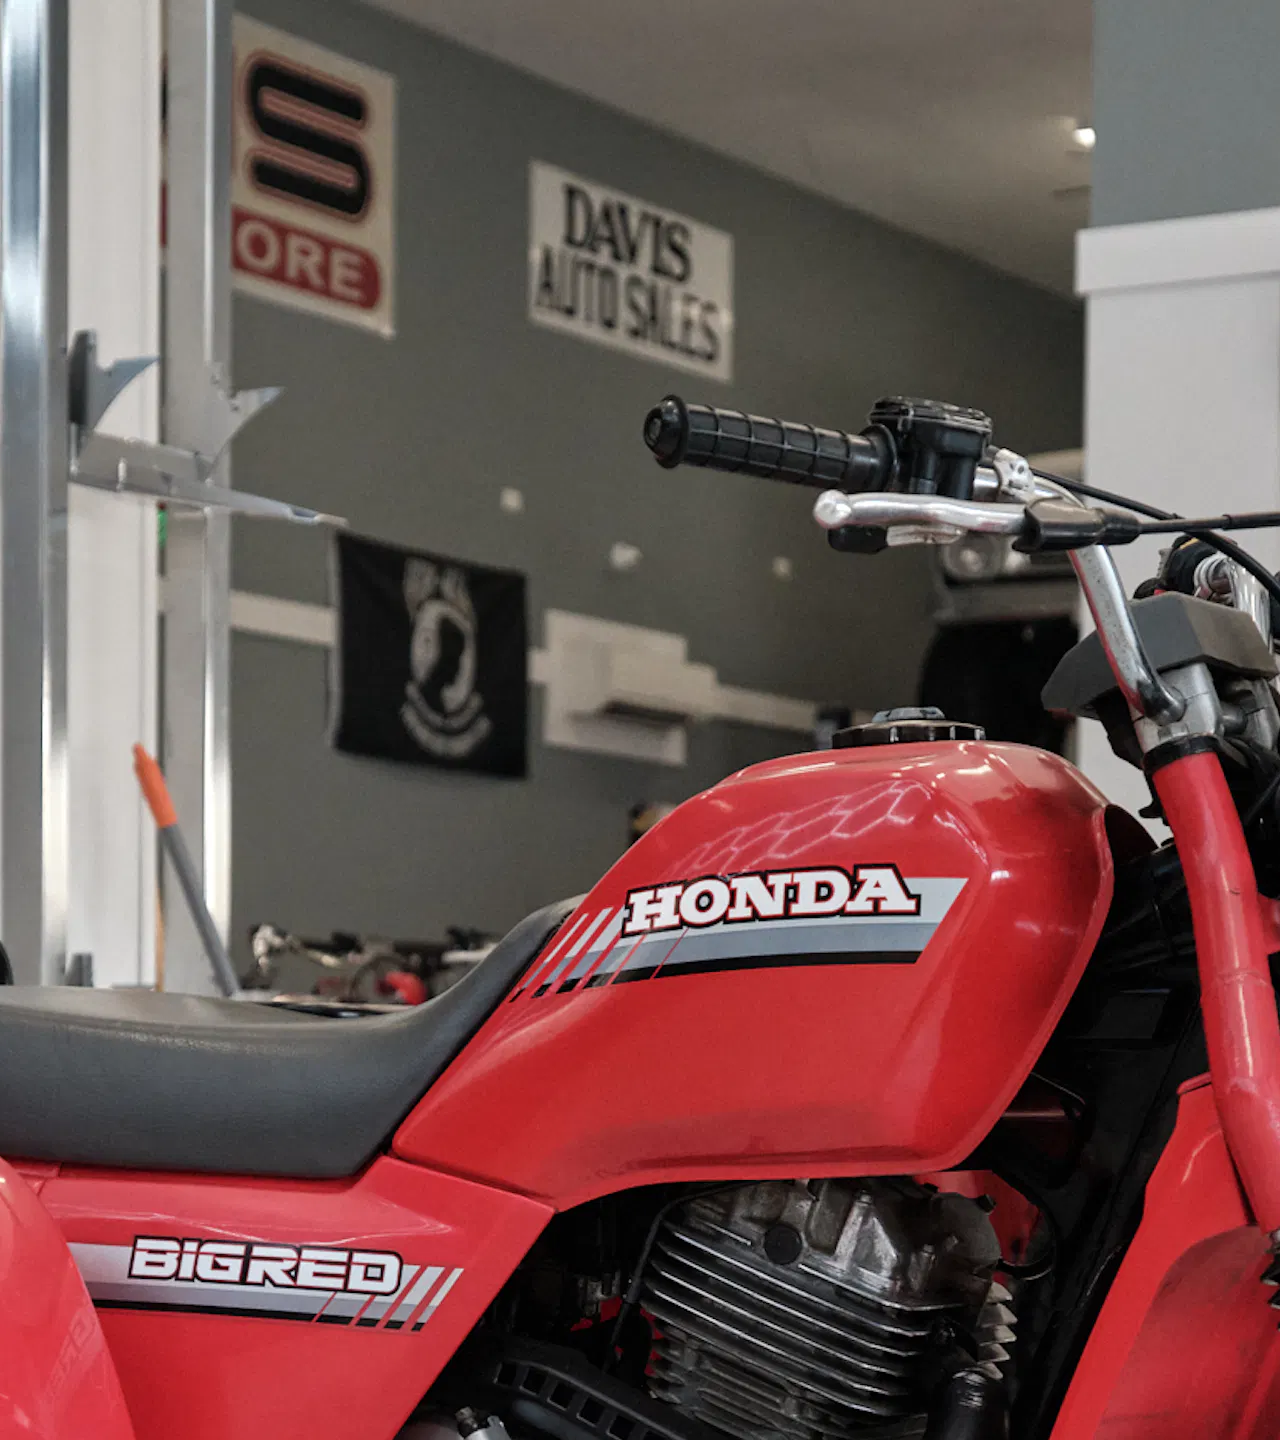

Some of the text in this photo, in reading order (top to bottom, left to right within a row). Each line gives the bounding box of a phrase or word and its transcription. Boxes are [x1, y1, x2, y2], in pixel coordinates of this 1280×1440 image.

[563, 182, 692, 284] DAVIS
[534, 243, 720, 361] AUTO SALES
[623, 864, 921, 937] HONDA
